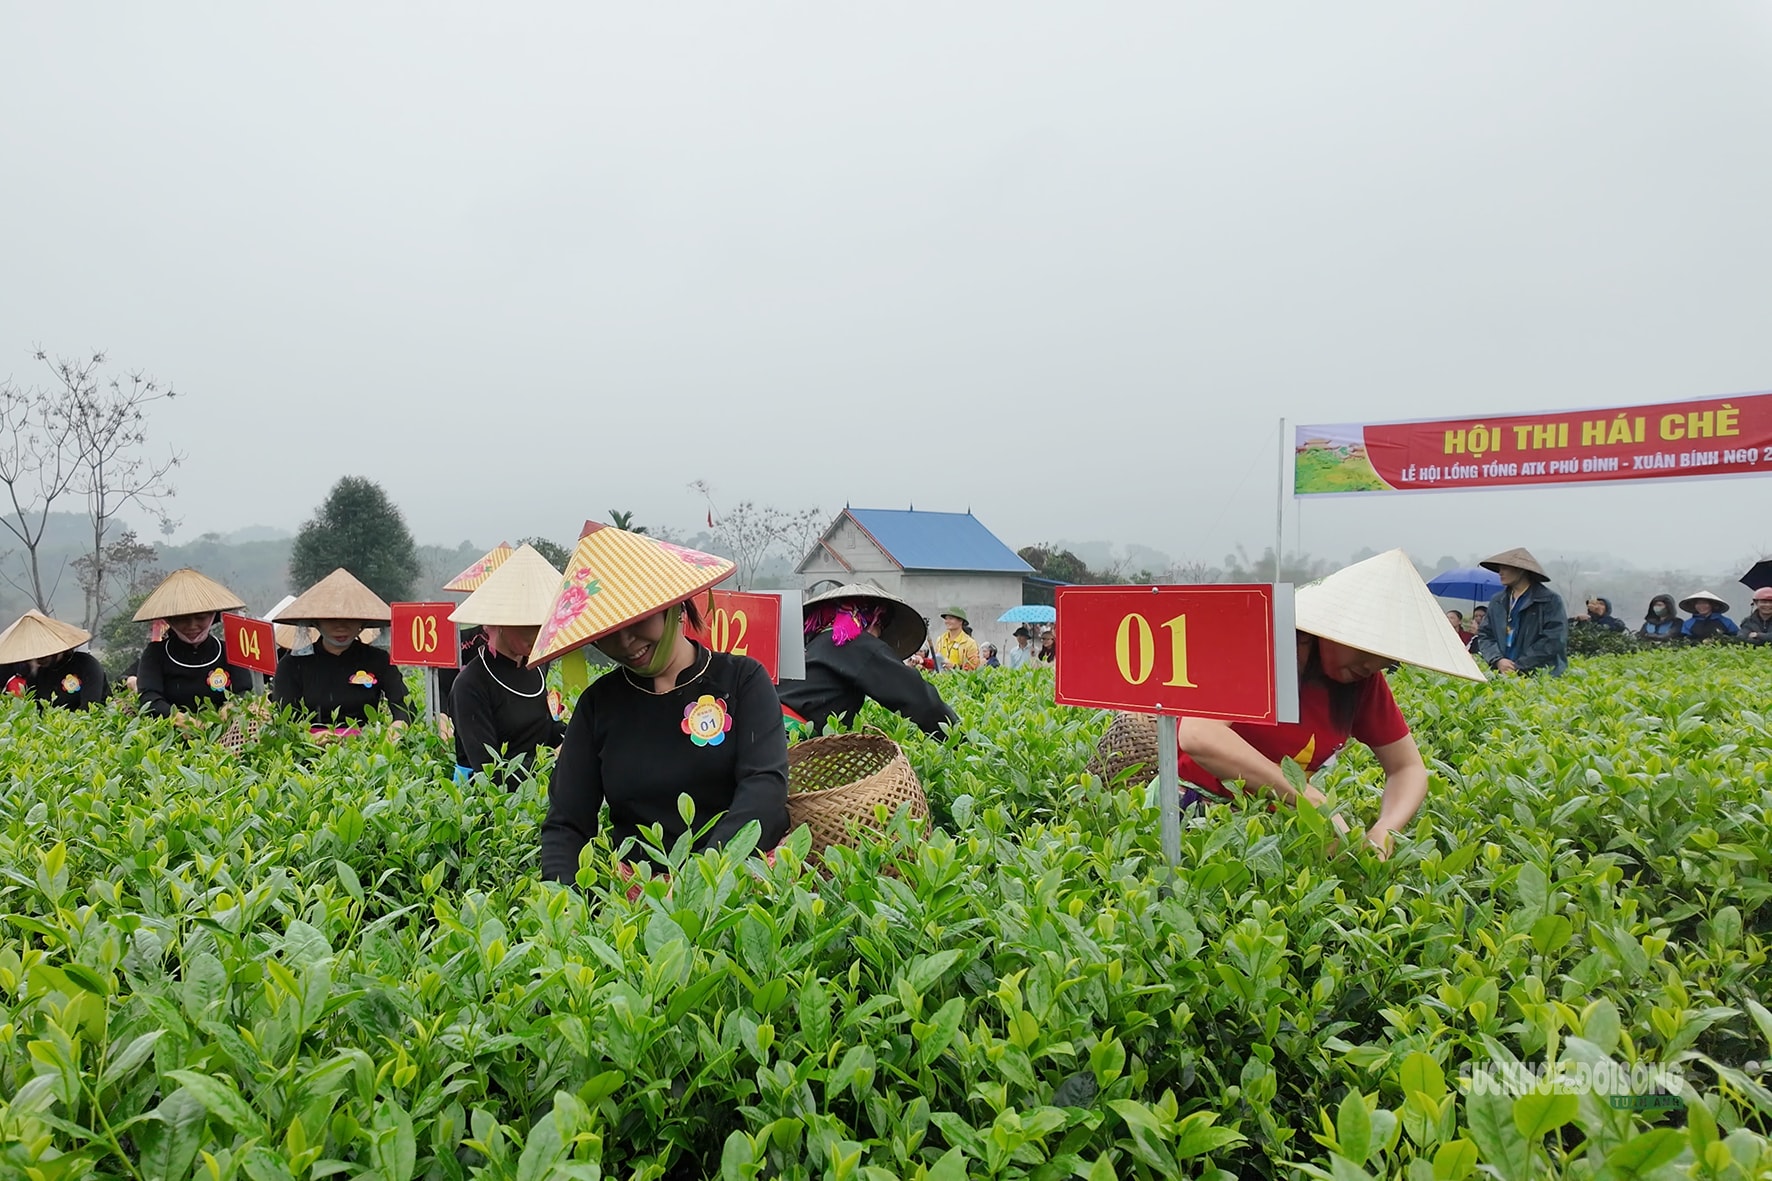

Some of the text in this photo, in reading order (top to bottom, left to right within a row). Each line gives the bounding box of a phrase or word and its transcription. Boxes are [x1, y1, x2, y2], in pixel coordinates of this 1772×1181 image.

[1444, 404, 1740, 459] HỘI THI HÁI CHÈ
[1419, 464, 1441, 483] HỘI
[1521, 461, 1546, 476] ATK
[1550, 457, 1579, 474] PHÚ
[1582, 456, 1619, 473] ĐÌNH
[1633, 451, 1676, 470] XUÂN
[1680, 449, 1719, 467] BÍNH
[1723, 448, 1759, 465] NGỌ
[239, 626, 260, 660] 04
[411, 615, 438, 653] 03
[710, 607, 749, 656] 02
[1115, 612, 1198, 688] 01
[700, 718, 716, 731] 01
